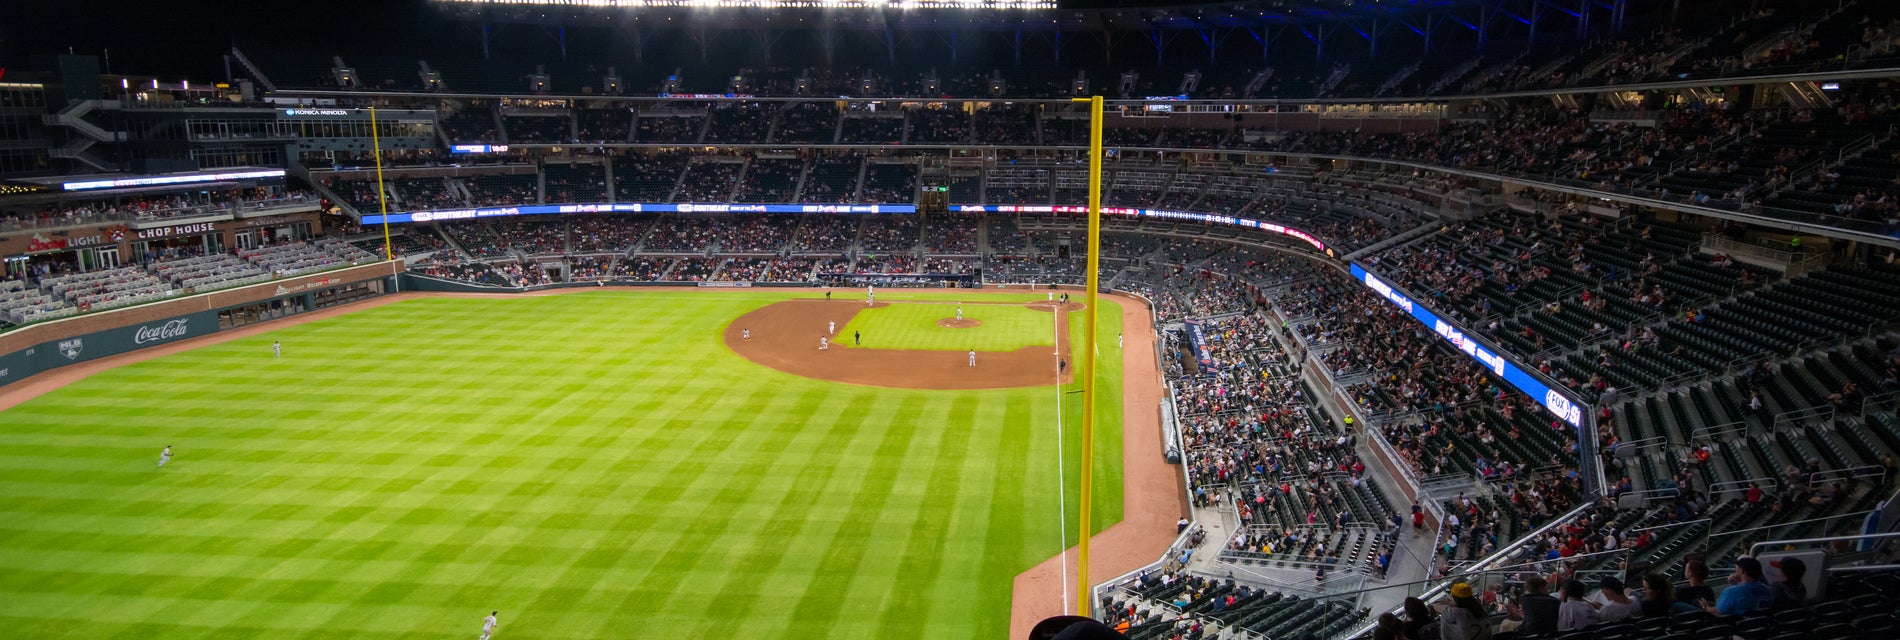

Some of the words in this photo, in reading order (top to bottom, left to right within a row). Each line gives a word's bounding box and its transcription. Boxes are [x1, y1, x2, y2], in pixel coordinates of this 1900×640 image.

[433, 210, 477, 220] SOUTHEAST
[138, 228, 170, 239] CHOP
[176, 222, 214, 234] HOUSE
[68, 235, 100, 247] LIGHT
[135, 317, 188, 344] Coca-Cola
[1552, 393, 1565, 411] FOX
